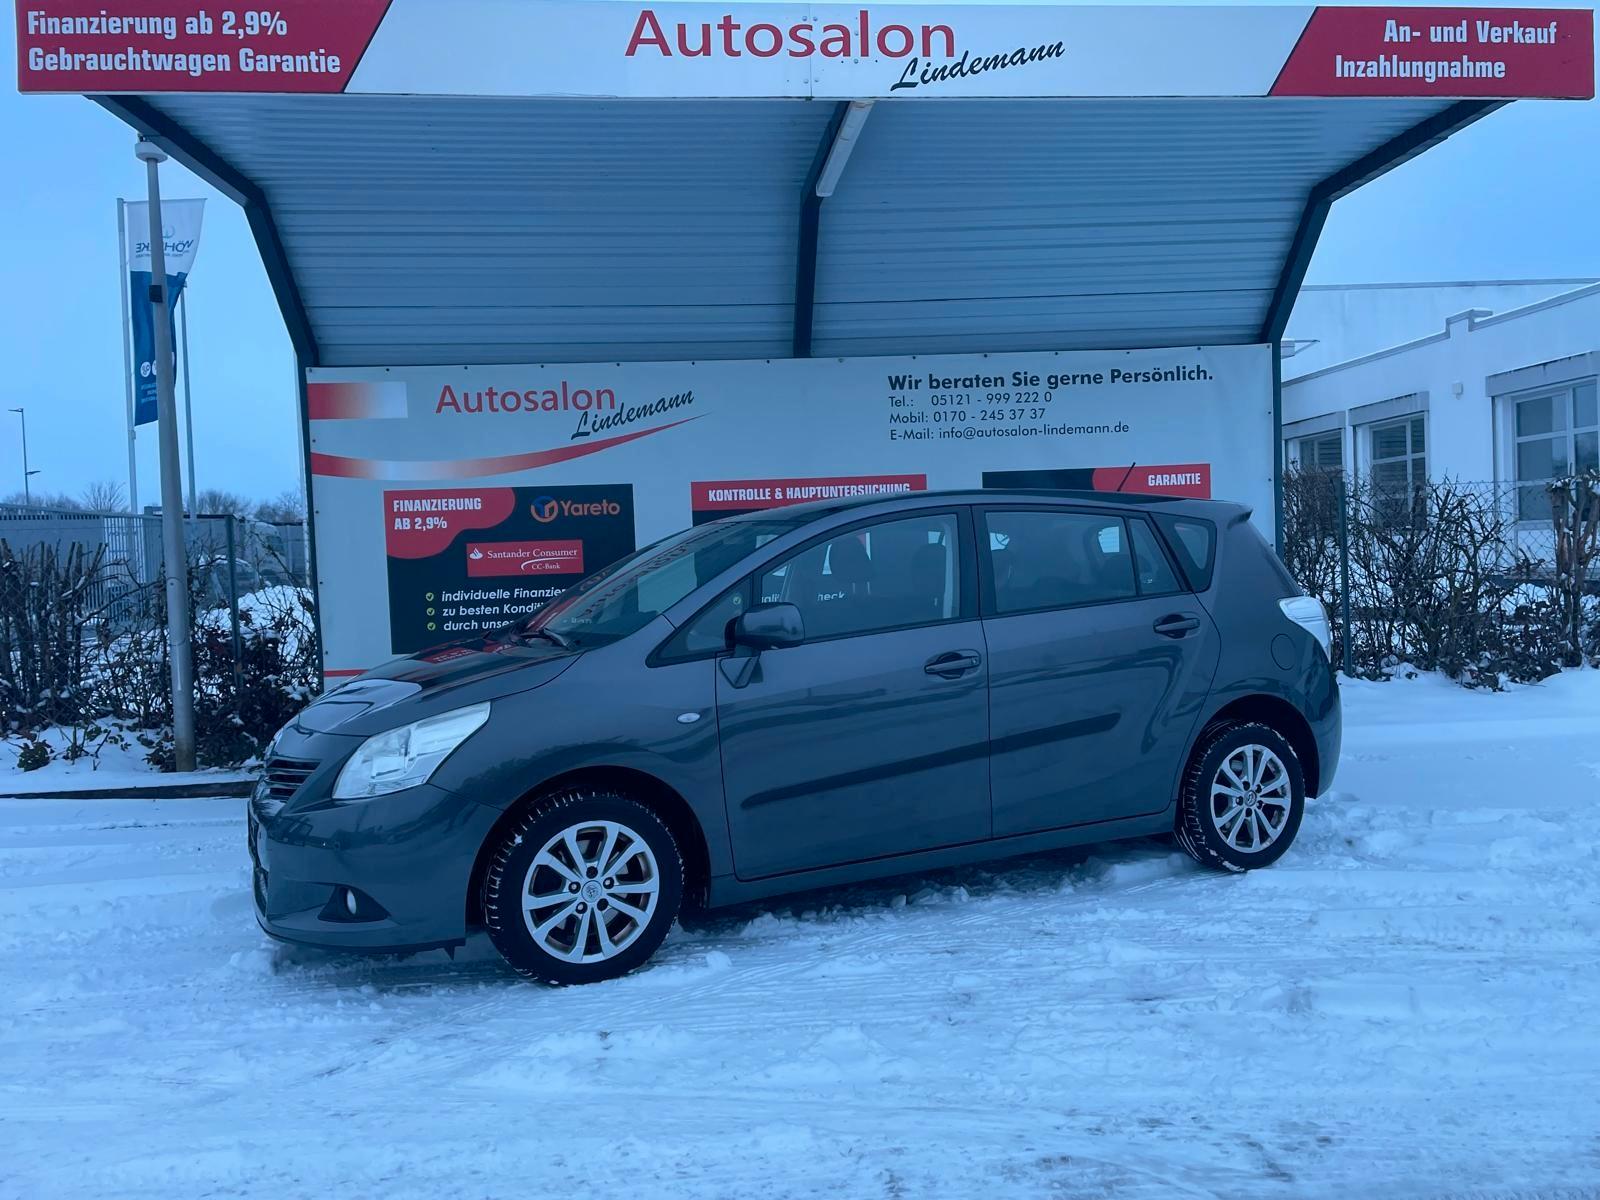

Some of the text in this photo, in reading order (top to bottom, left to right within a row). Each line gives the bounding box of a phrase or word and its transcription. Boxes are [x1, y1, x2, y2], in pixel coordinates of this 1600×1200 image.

[27, 10, 288, 40] Finanzierung ab 2,9%
[625, 10, 955, 58] Autosalon
[1383, 19, 1557, 44] An- und Verkauf
[28, 47, 341, 77] Gebrauchtwagen Garantie
[890, 40, 1066, 92] Lindemann
[1335, 54, 1506, 83] Inzahlungnahme
[888, 365, 1214, 391] Wir beraten Sie gerne Persönlich.
[435, 381, 615, 414] Autosalon
[888, 396, 914, 408] Tel.:
[931, 394, 971, 406] 05121
[986, 393, 1010, 405] 999
[1015, 392, 1039, 404] 222
[1044, 391, 1052, 403] 0
[571, 390, 695, 441] Lindemann
[889, 411, 928, 424] Mobil:
[933, 410, 966, 423] 0170
[980, 409, 1004, 421] 245
[1009, 408, 1025, 420] 37
[1029, 408, 1046, 420] 37
[890, 422, 1129, 441] E-Mail: info@autosalon-lindemann.de
[1147, 472, 1201, 487] GARANTIE
[708, 483, 910, 502] KONTROLLE & HAUPTUNTERSUCHUNG
[393, 497, 482, 513] FINANZIERUNG
[560, 499, 620, 517] Yareto
[394, 517, 447, 532] AB 2,9%
[487, 548, 578, 560] Santander Consumer
[531, 562, 560, 570] CC-Bank
[441, 588, 510, 602] individuelle
[443, 608, 456, 617] zu
[460, 604, 500, 616] besten
[444, 620, 478, 631] durch
